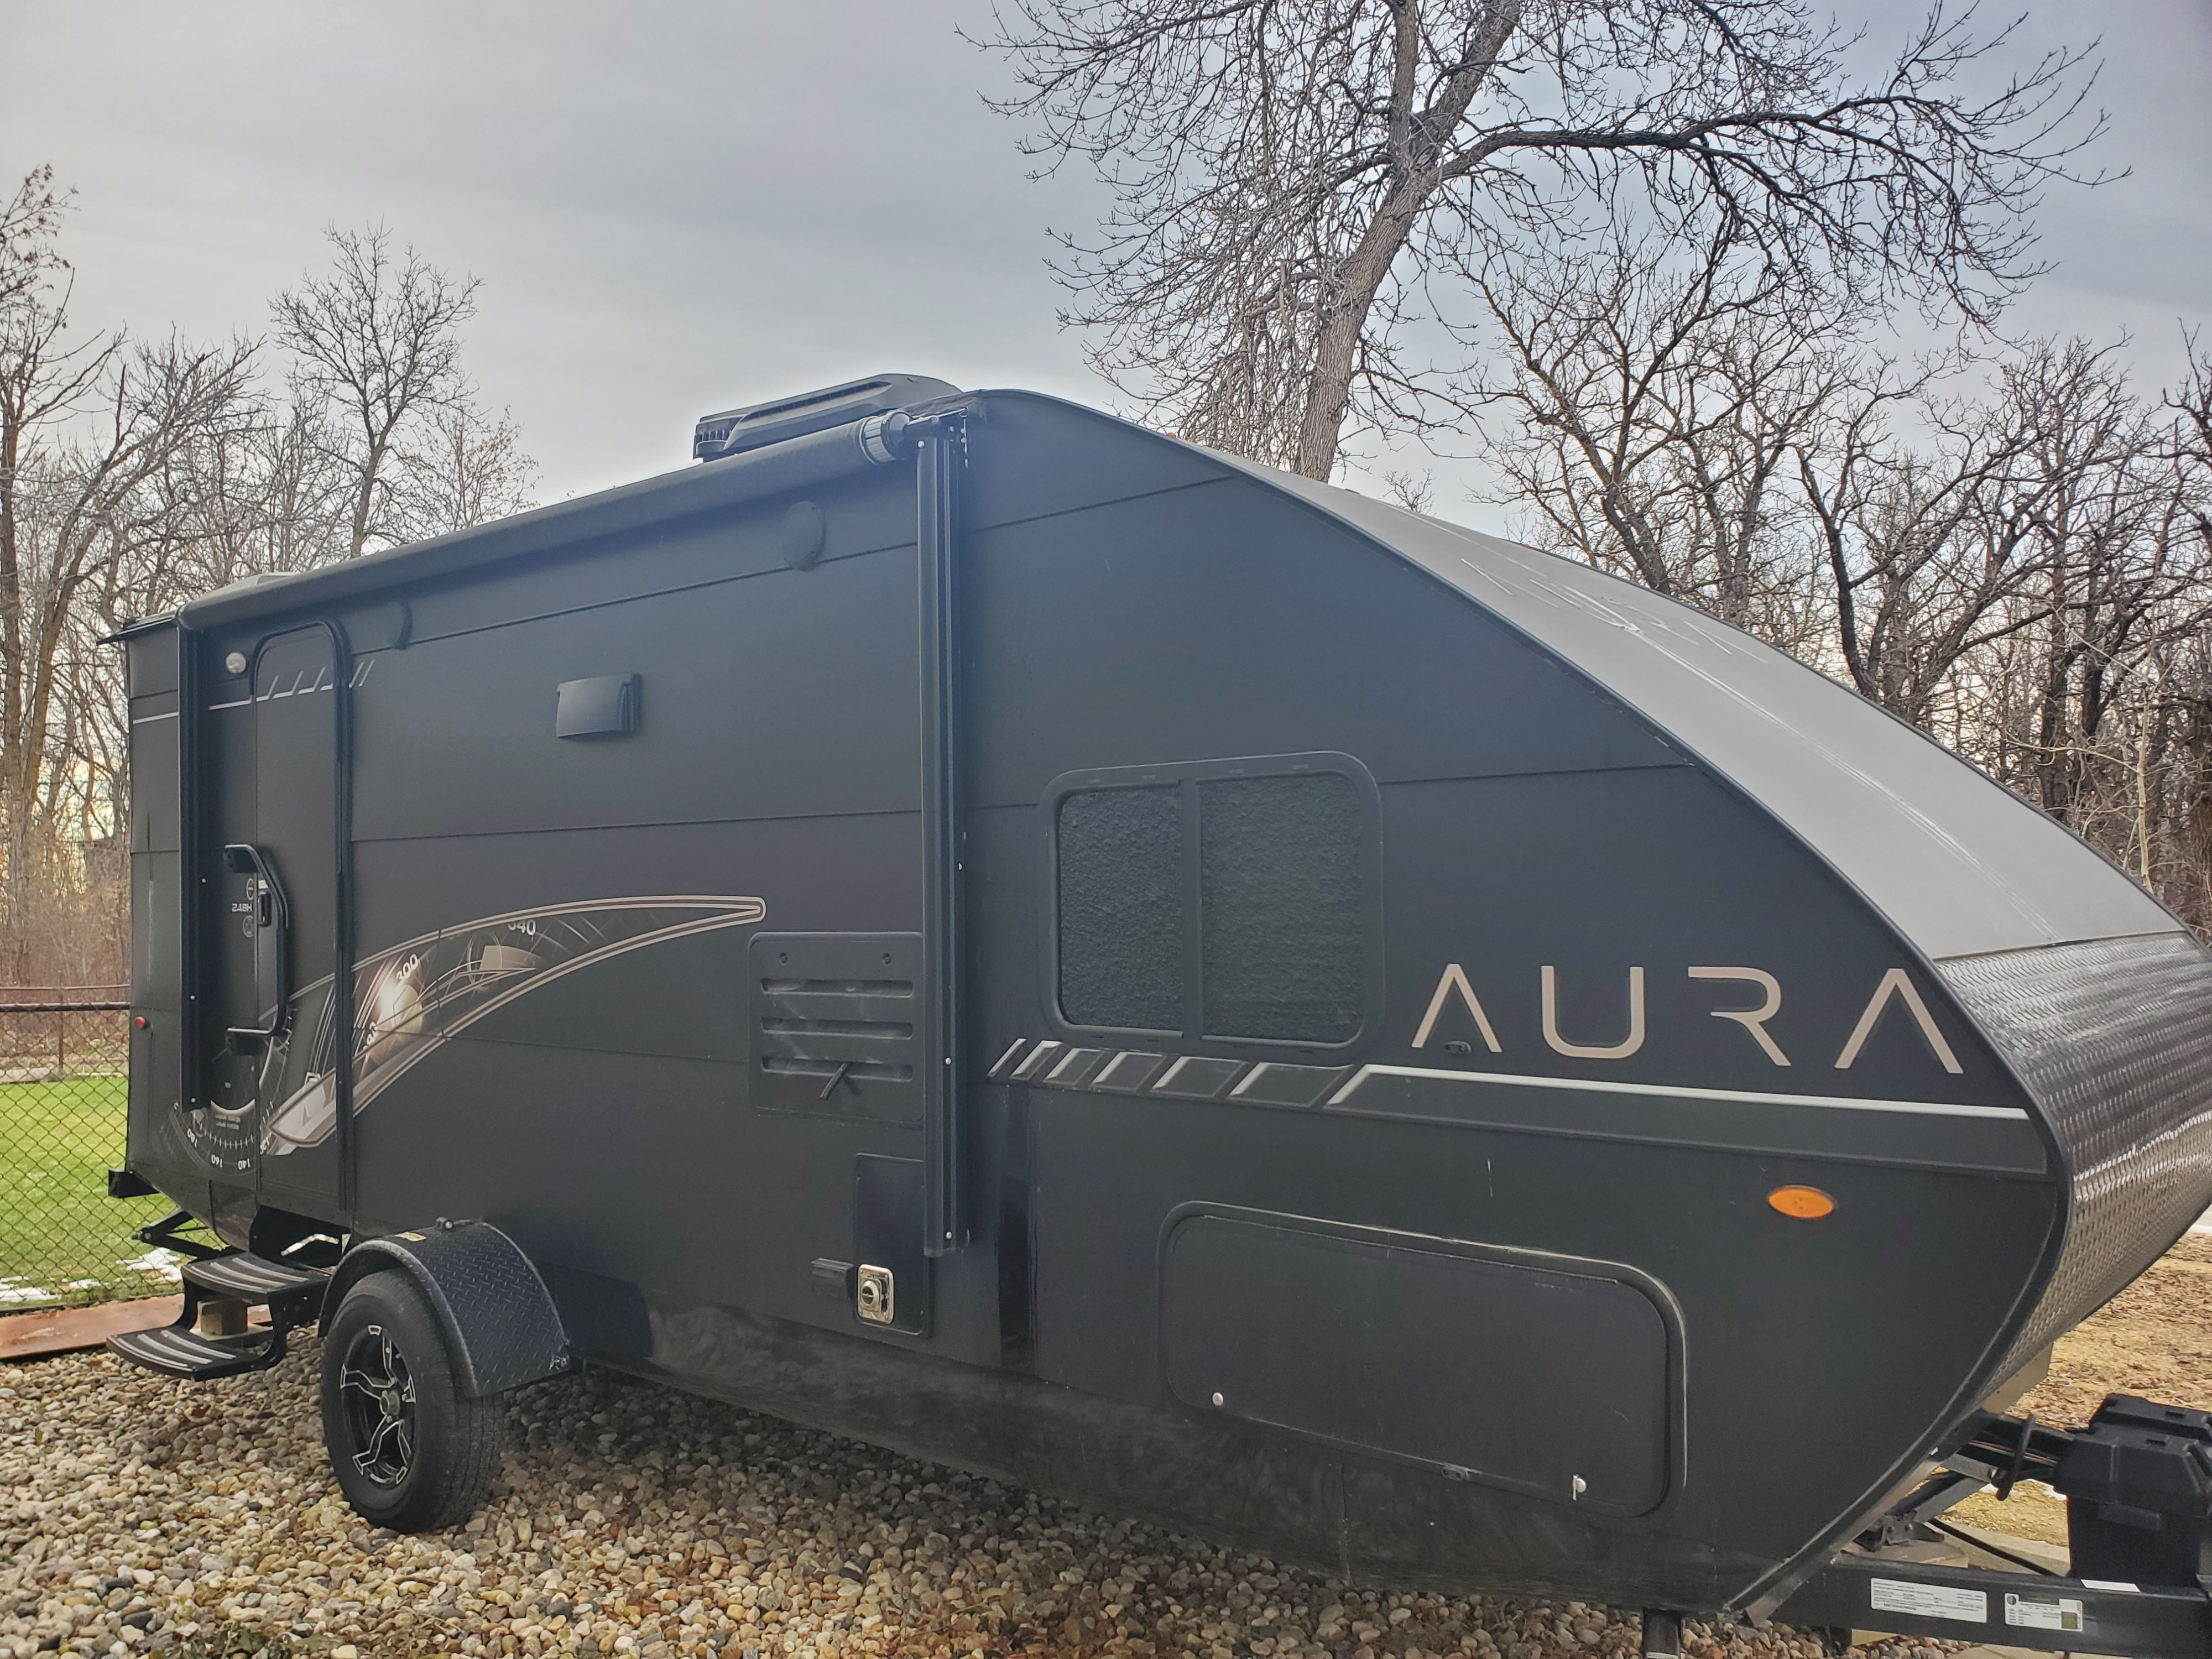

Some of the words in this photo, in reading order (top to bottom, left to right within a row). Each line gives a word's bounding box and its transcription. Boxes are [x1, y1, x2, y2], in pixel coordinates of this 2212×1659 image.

[396, 953, 419, 981] 300
[1411, 963, 1964, 1074] AURA
[187, 1128, 198, 1147] 180
[211, 1154, 222, 1167] 160
[238, 1158, 251, 1170] 140
